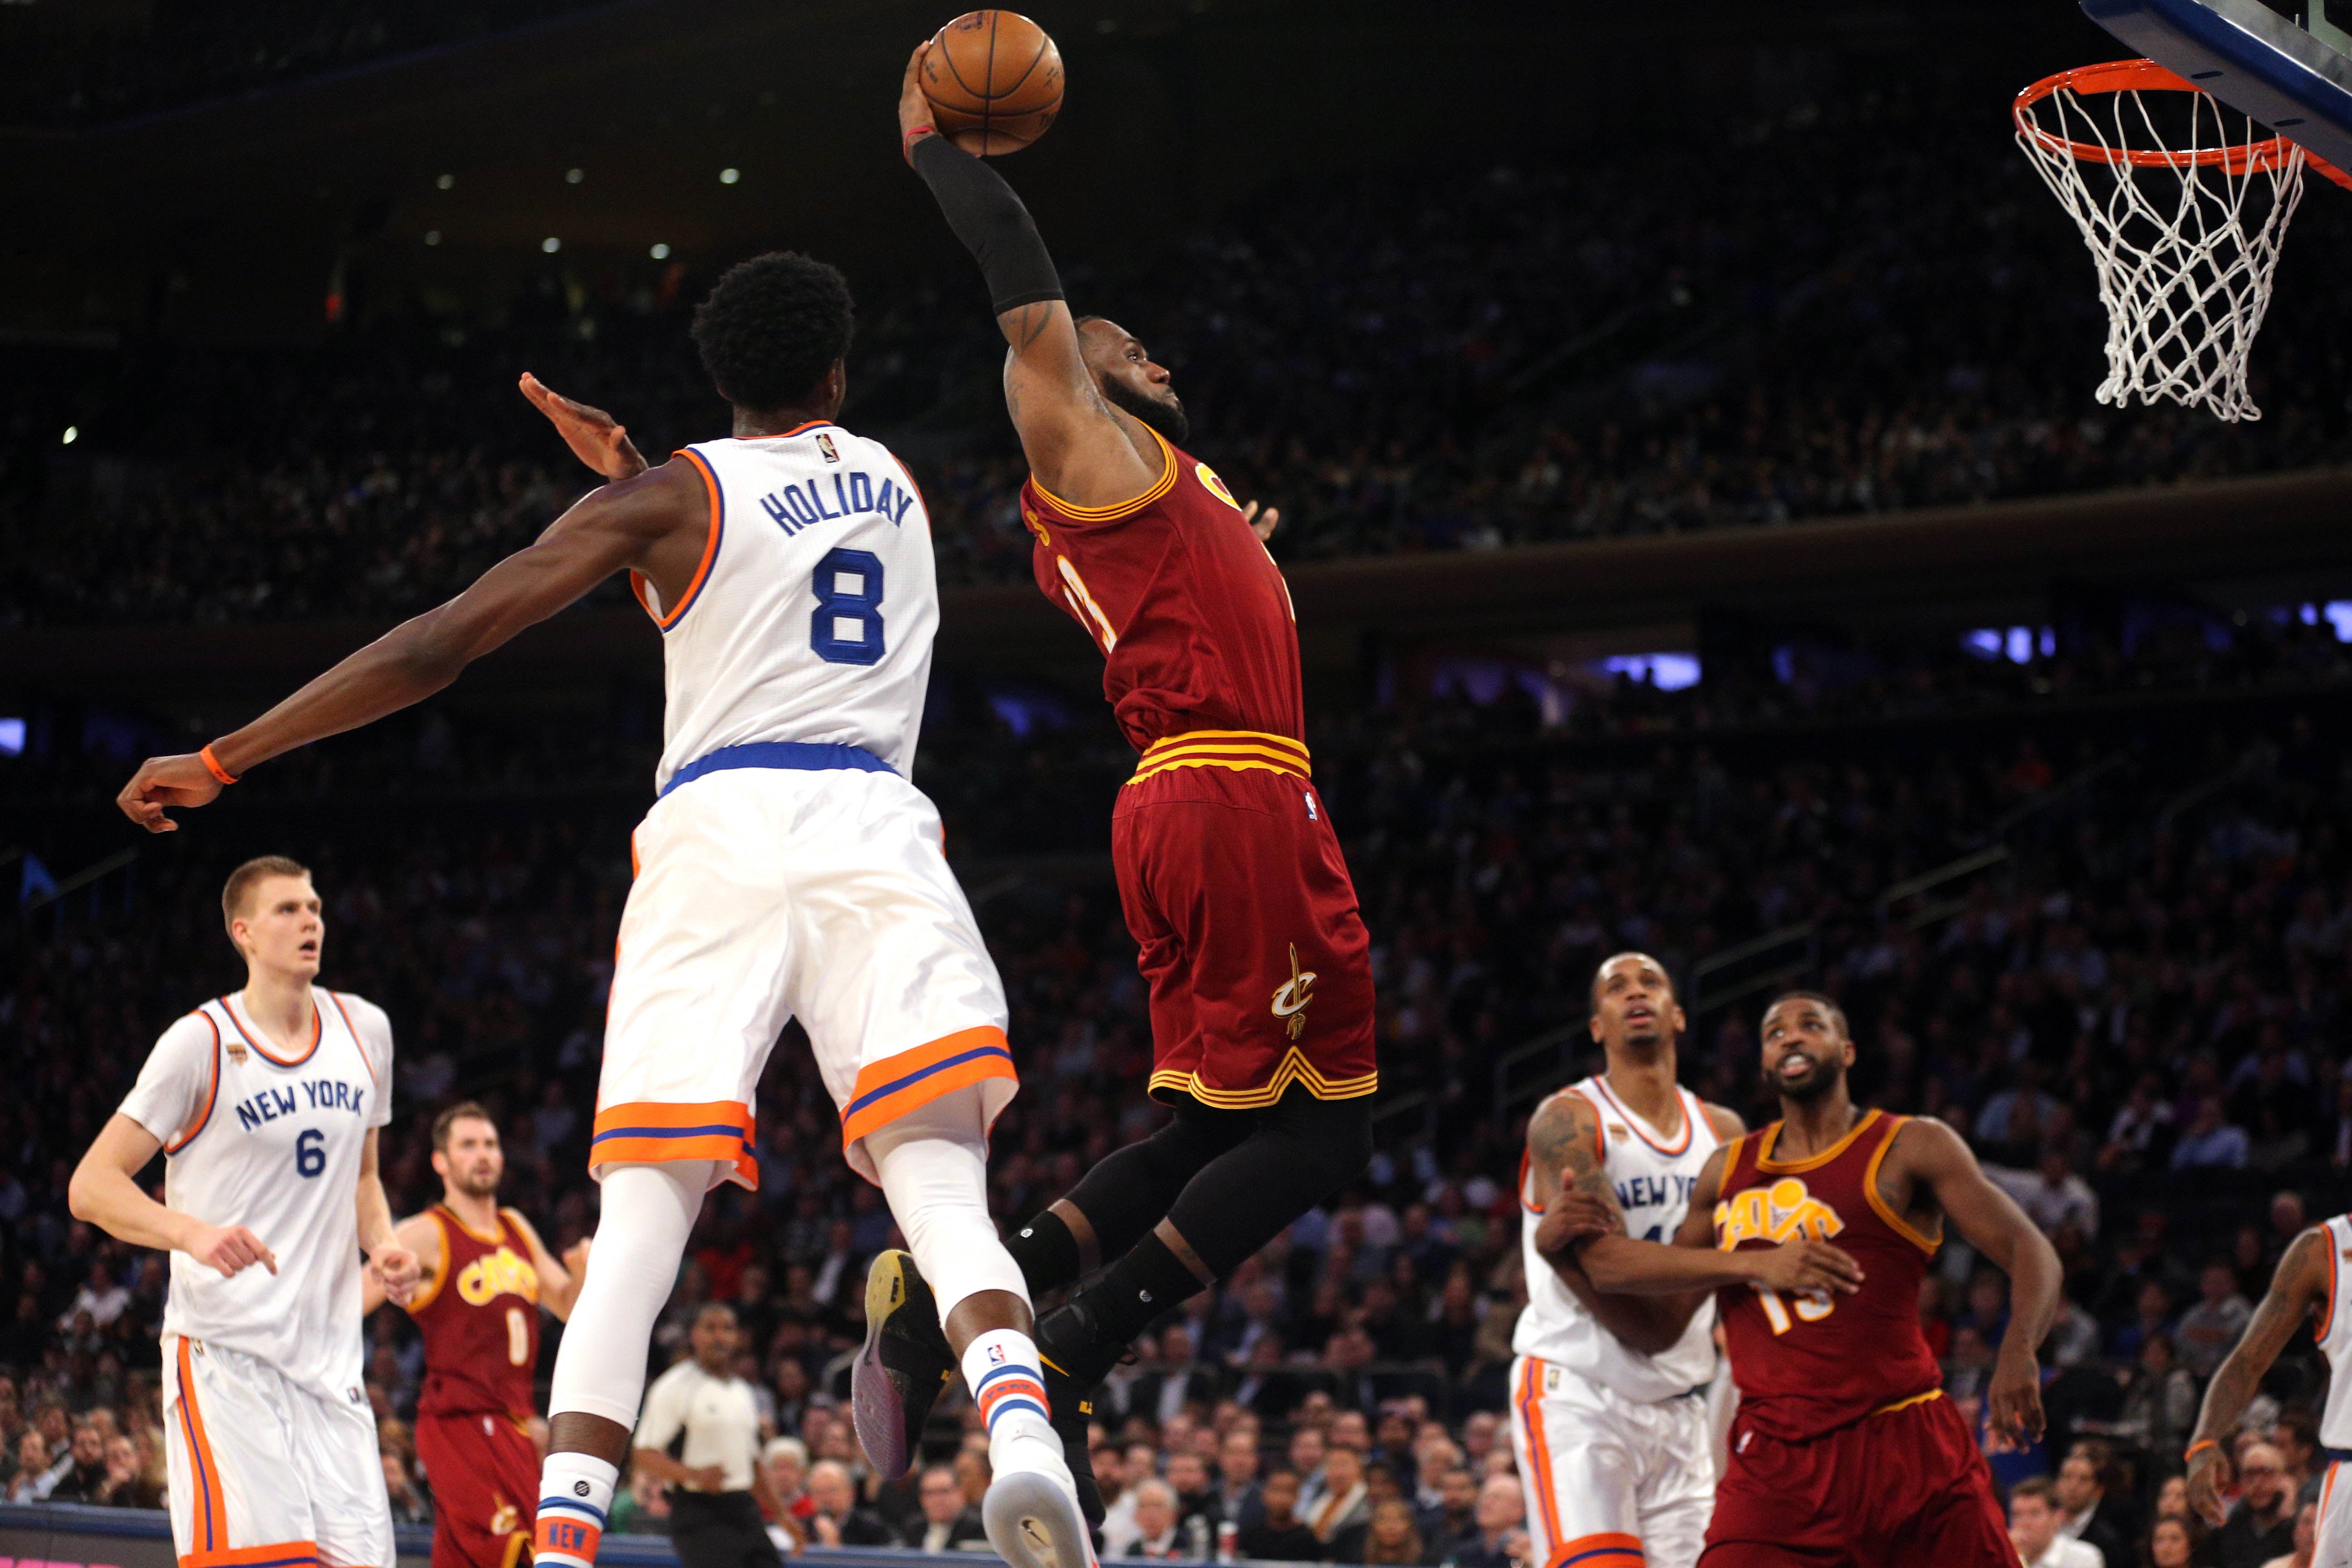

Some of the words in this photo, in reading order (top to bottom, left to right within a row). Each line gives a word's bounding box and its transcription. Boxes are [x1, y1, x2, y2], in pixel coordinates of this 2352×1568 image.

[760, 472, 913, 537] HOLIDAY
[811, 547, 886, 666] 8
[235, 1087, 296, 1132] NEW
[301, 1081, 364, 1117] YORK
[295, 1128, 326, 1178] 6
